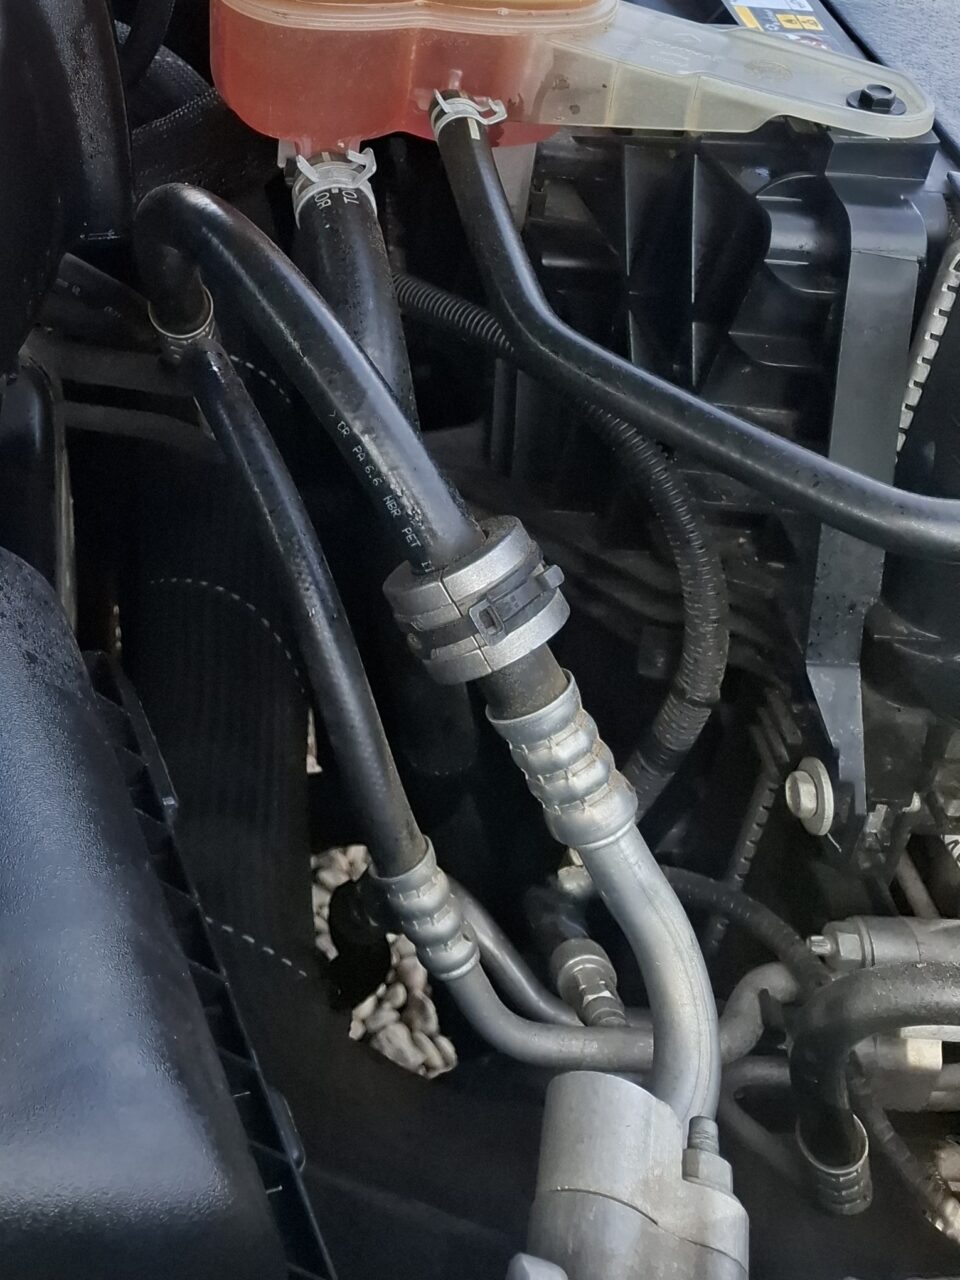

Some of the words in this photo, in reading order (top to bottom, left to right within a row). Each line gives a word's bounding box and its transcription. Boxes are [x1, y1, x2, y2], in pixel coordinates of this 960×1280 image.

[352, 445, 366, 462] PA
[364, 466, 383, 486] 6.6
[383, 495, 402, 517] NBR
[401, 527, 422, 547] PET
